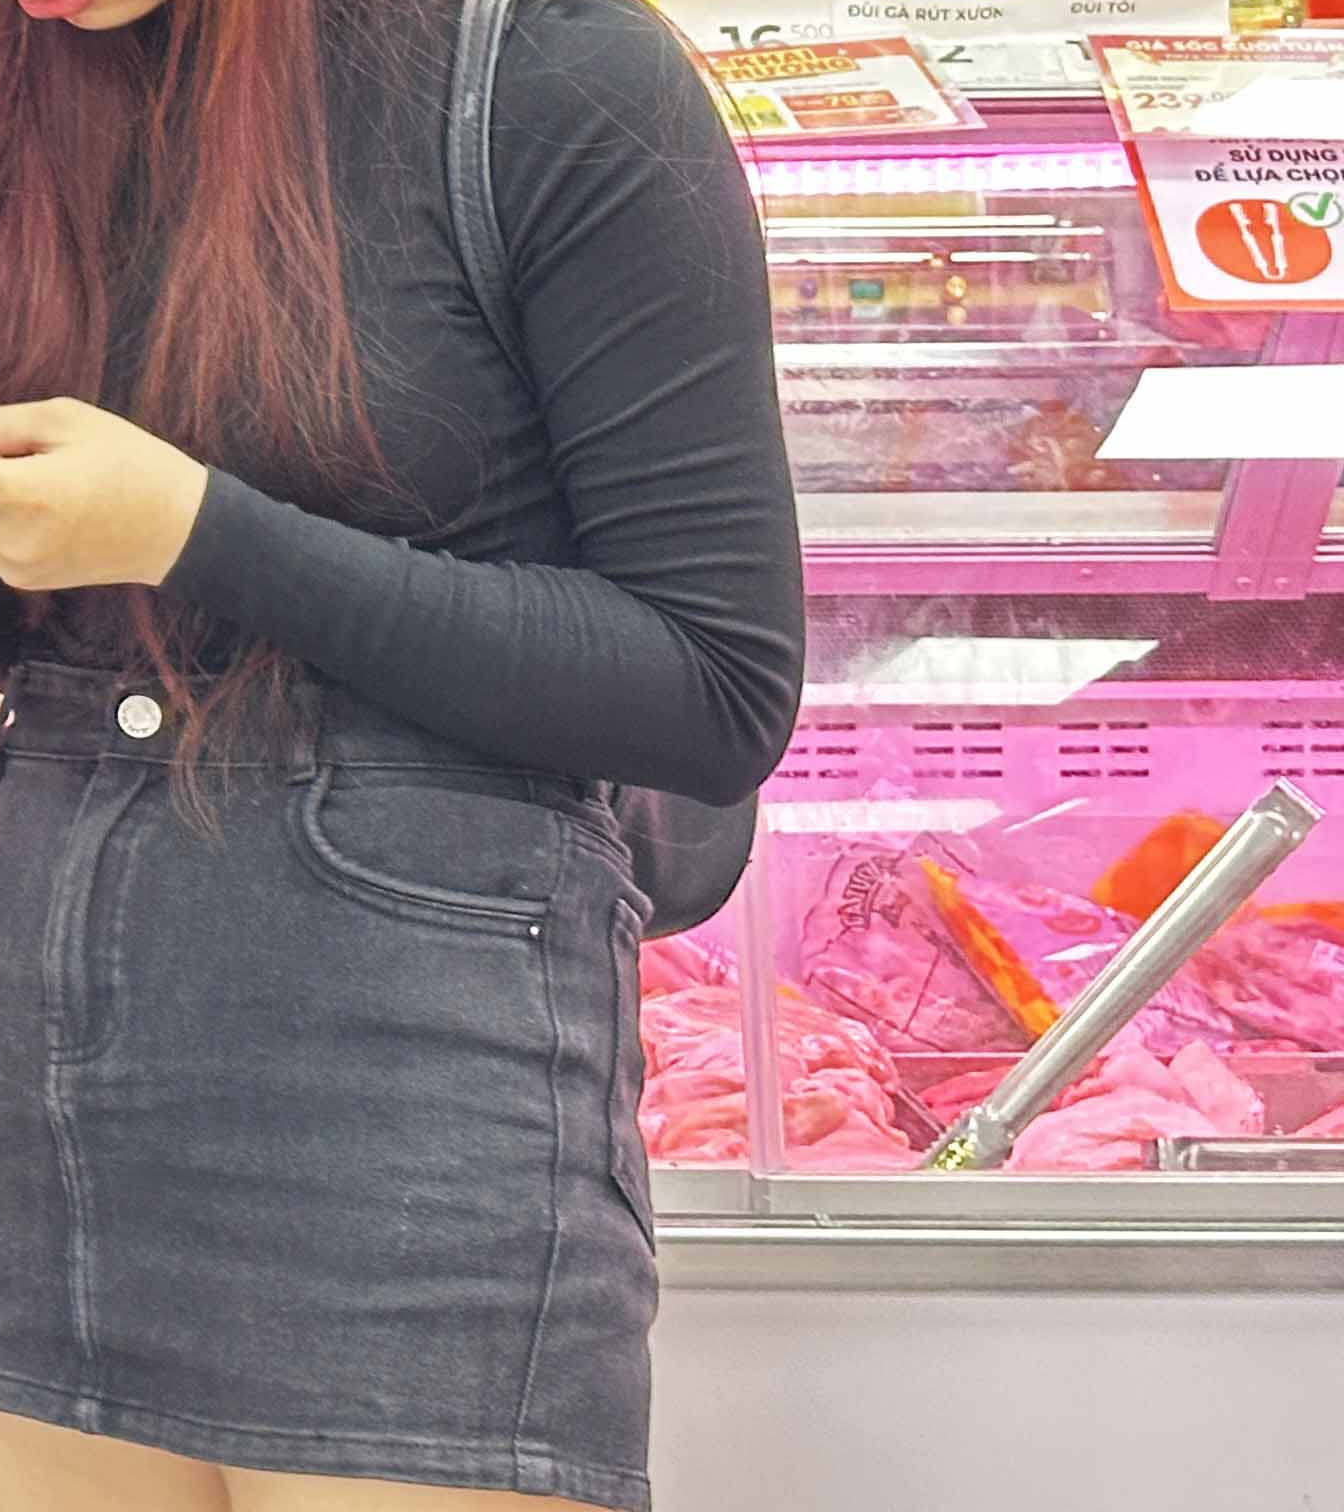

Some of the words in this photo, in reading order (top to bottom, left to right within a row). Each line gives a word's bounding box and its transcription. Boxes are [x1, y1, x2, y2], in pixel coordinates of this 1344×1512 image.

[915, 5, 949, 22] RÚT
[957, 6, 1005, 23] XƯƠN
[732, 51, 814, 67] KHAI
[1229, 145, 1262, 162] SỬ
[1267, 149, 1338, 166] DỤNG
[1195, 163, 1229, 182] ĐỂ
[1234, 168, 1281, 185] LỰA
